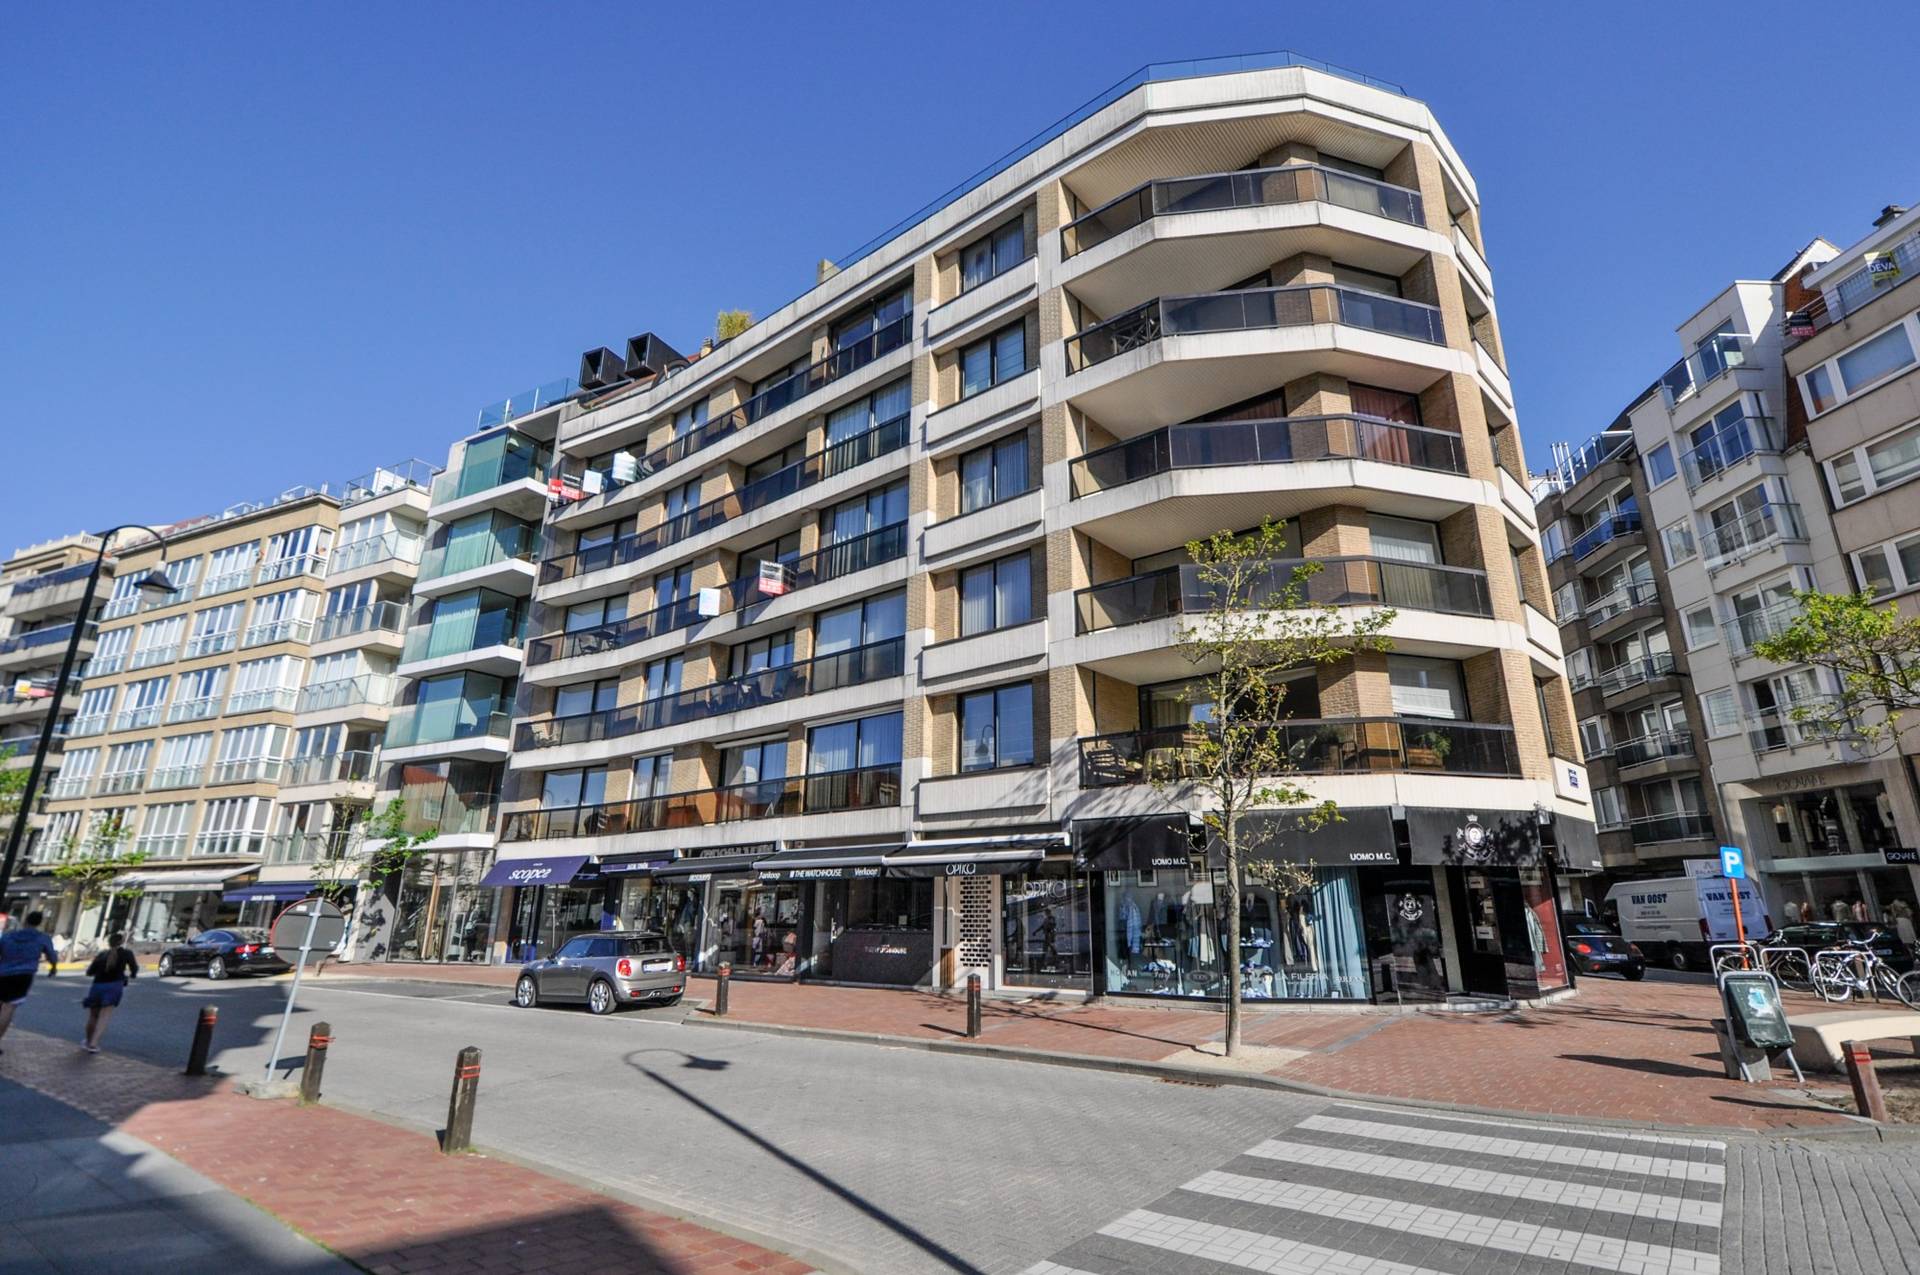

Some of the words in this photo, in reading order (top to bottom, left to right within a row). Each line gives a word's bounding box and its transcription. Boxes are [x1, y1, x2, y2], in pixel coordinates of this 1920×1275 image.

[1151, 858, 1173, 866] UOMO
[1173, 857, 1188, 865] M.C.
[1349, 852, 1375, 861] UOMO
[1375, 851, 1394, 860] M.C.
[1723, 851, 1739, 873] P
[758, 871, 781, 880] Aankoop
[795, 869, 804, 878] THE
[854, 866, 879, 877] Verkoop
[1631, 894, 1646, 905] VAN
[1646, 893, 1668, 904] OOST
[1705, 892, 1726, 902] VAN
[1727, 891, 1751, 900] OST
